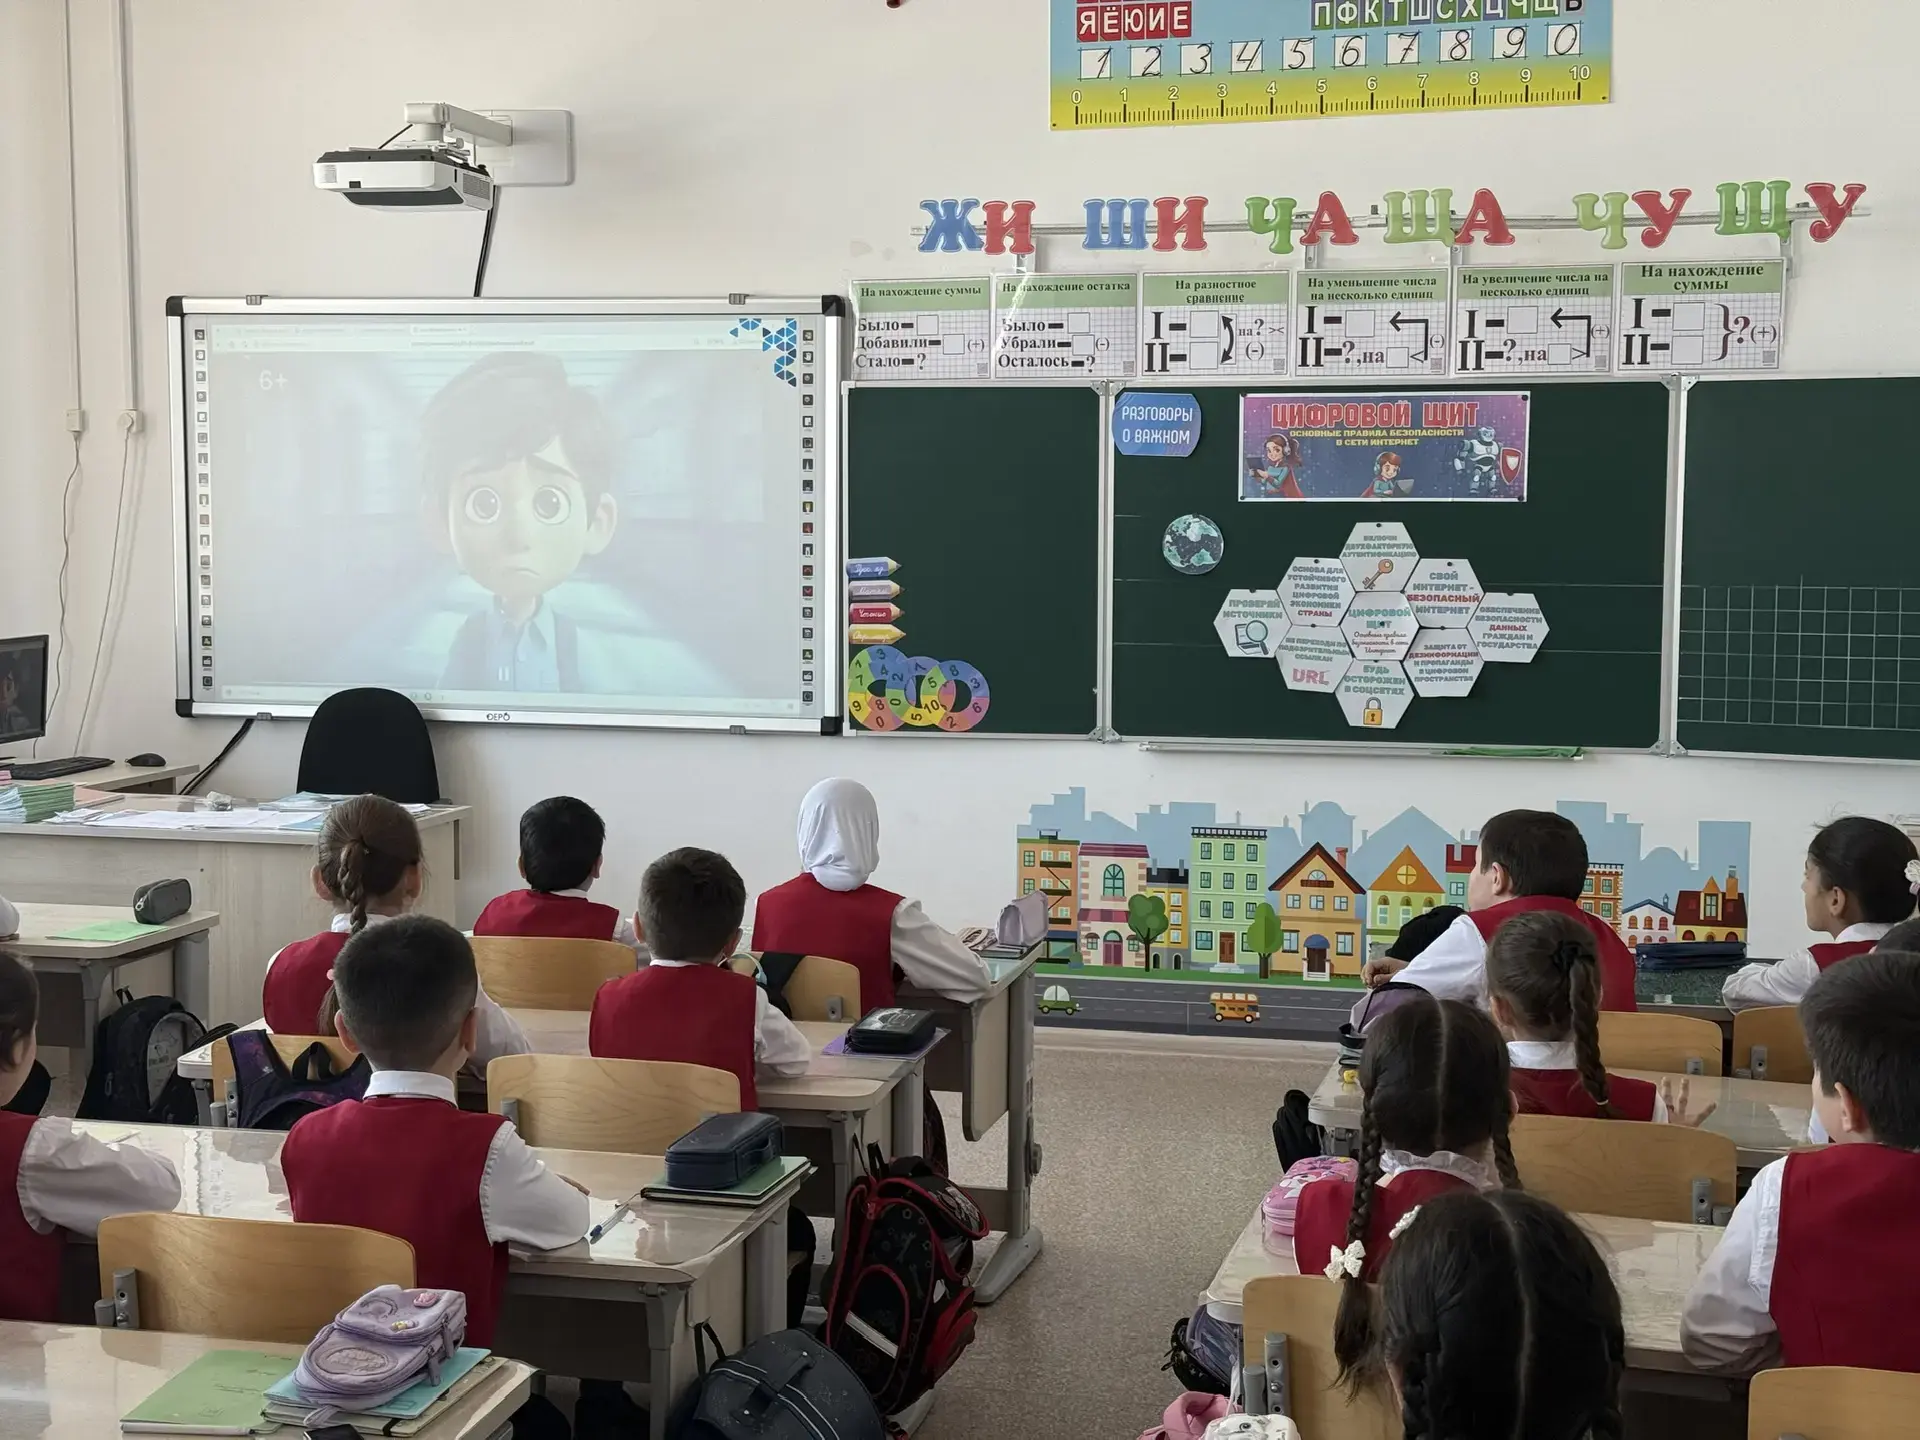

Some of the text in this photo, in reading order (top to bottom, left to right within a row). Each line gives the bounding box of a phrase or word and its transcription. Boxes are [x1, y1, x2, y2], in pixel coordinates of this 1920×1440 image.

[1097, 23, 1578, 78] 1 2 3 4 5 6 7 8 9 0
[1071, 65, 1590, 104] 0 1 2 3 4 5 6 7 8 9 10
[918, 179, 1867, 255] ЖИ ШИ ЧА ЩА ЧУ ЩУ
[1641, 265, 1764, 277] На нахождение
[1308, 277, 1437, 290] На уменьшение числа
[1463, 274, 1609, 286] На увеличение числа на
[1002, 283, 1016, 292] На
[1087, 283, 1130, 291] остатка
[1175, 280, 1256, 292] На разностное
[1674, 280, 1728, 294] суммы
[861, 287, 981, 298] На нахождение суммы
[1311, 290, 1433, 300] на несколько единиц
[1480, 287, 1590, 297] несколько единиц
[1186, 293, 1244, 305] сравнение
[259, 370, 289, 390] 6+
[1122, 406, 1193, 422] РАЗГОВОРЫ
[1271, 400, 1479, 429] ЦИФРОВОЙ ЩИТ
[1122, 428, 1190, 444] О ВАЖНОМ
[1389, 429, 1464, 437] БЕЗОПАСНОСТИ
[1370, 438, 1420, 446] ИНТЕРНЕТ
[1287, 574, 1346, 583] УСТОЙЧИВОГО
[1429, 571, 1458, 580] СВОЙ
[1294, 583, 1338, 591] РАЗВИТИЯ
[1413, 583, 1468, 591] ИНТЕРНЕТ
[1292, 591, 1340, 600] ЦИФРОВОЙ
[1407, 593, 1480, 602] БЕЗОПАСНЫЙ
[1229, 598, 1280, 608] ПРОВЕРЯЙ
[1289, 600, 1341, 609] ЭКОНОМИКИ
[1223, 610, 1283, 619] ИСТОЧНИКИ
[1298, 609, 1332, 617] СТРАНЫ
[1348, 607, 1411, 618] ЦИФРОВОЙ
[1415, 605, 1470, 614] ИНТЕРНЕТ
[1475, 615, 1542, 624] БЕЗОПАСНОСТИ
[1489, 624, 1527, 632] ДАННЫХ
[1483, 633, 1525, 641] ГРАЖДАН
[1476, 641, 1538, 650] ГОСУДАРСТВА
[876, 649, 886, 659] 3
[1409, 651, 1479, 659] ДЕЗИНФОРМАЦИИ
[881, 664, 889, 676] 4
[949, 665, 959, 676] 8
[1363, 665, 1389, 674] БУДЬ
[1292, 668, 1330, 685] URL
[1344, 675, 1406, 685] ОСТОРОЖЕН
[928, 677, 938, 689] 5
[970, 677, 980, 689] 3
[1344, 685, 1405, 695] В СОЦСЕТЯХ
[875, 699, 885, 710] 8
[924, 699, 940, 714] 10
[946, 716, 957, 729] 2
